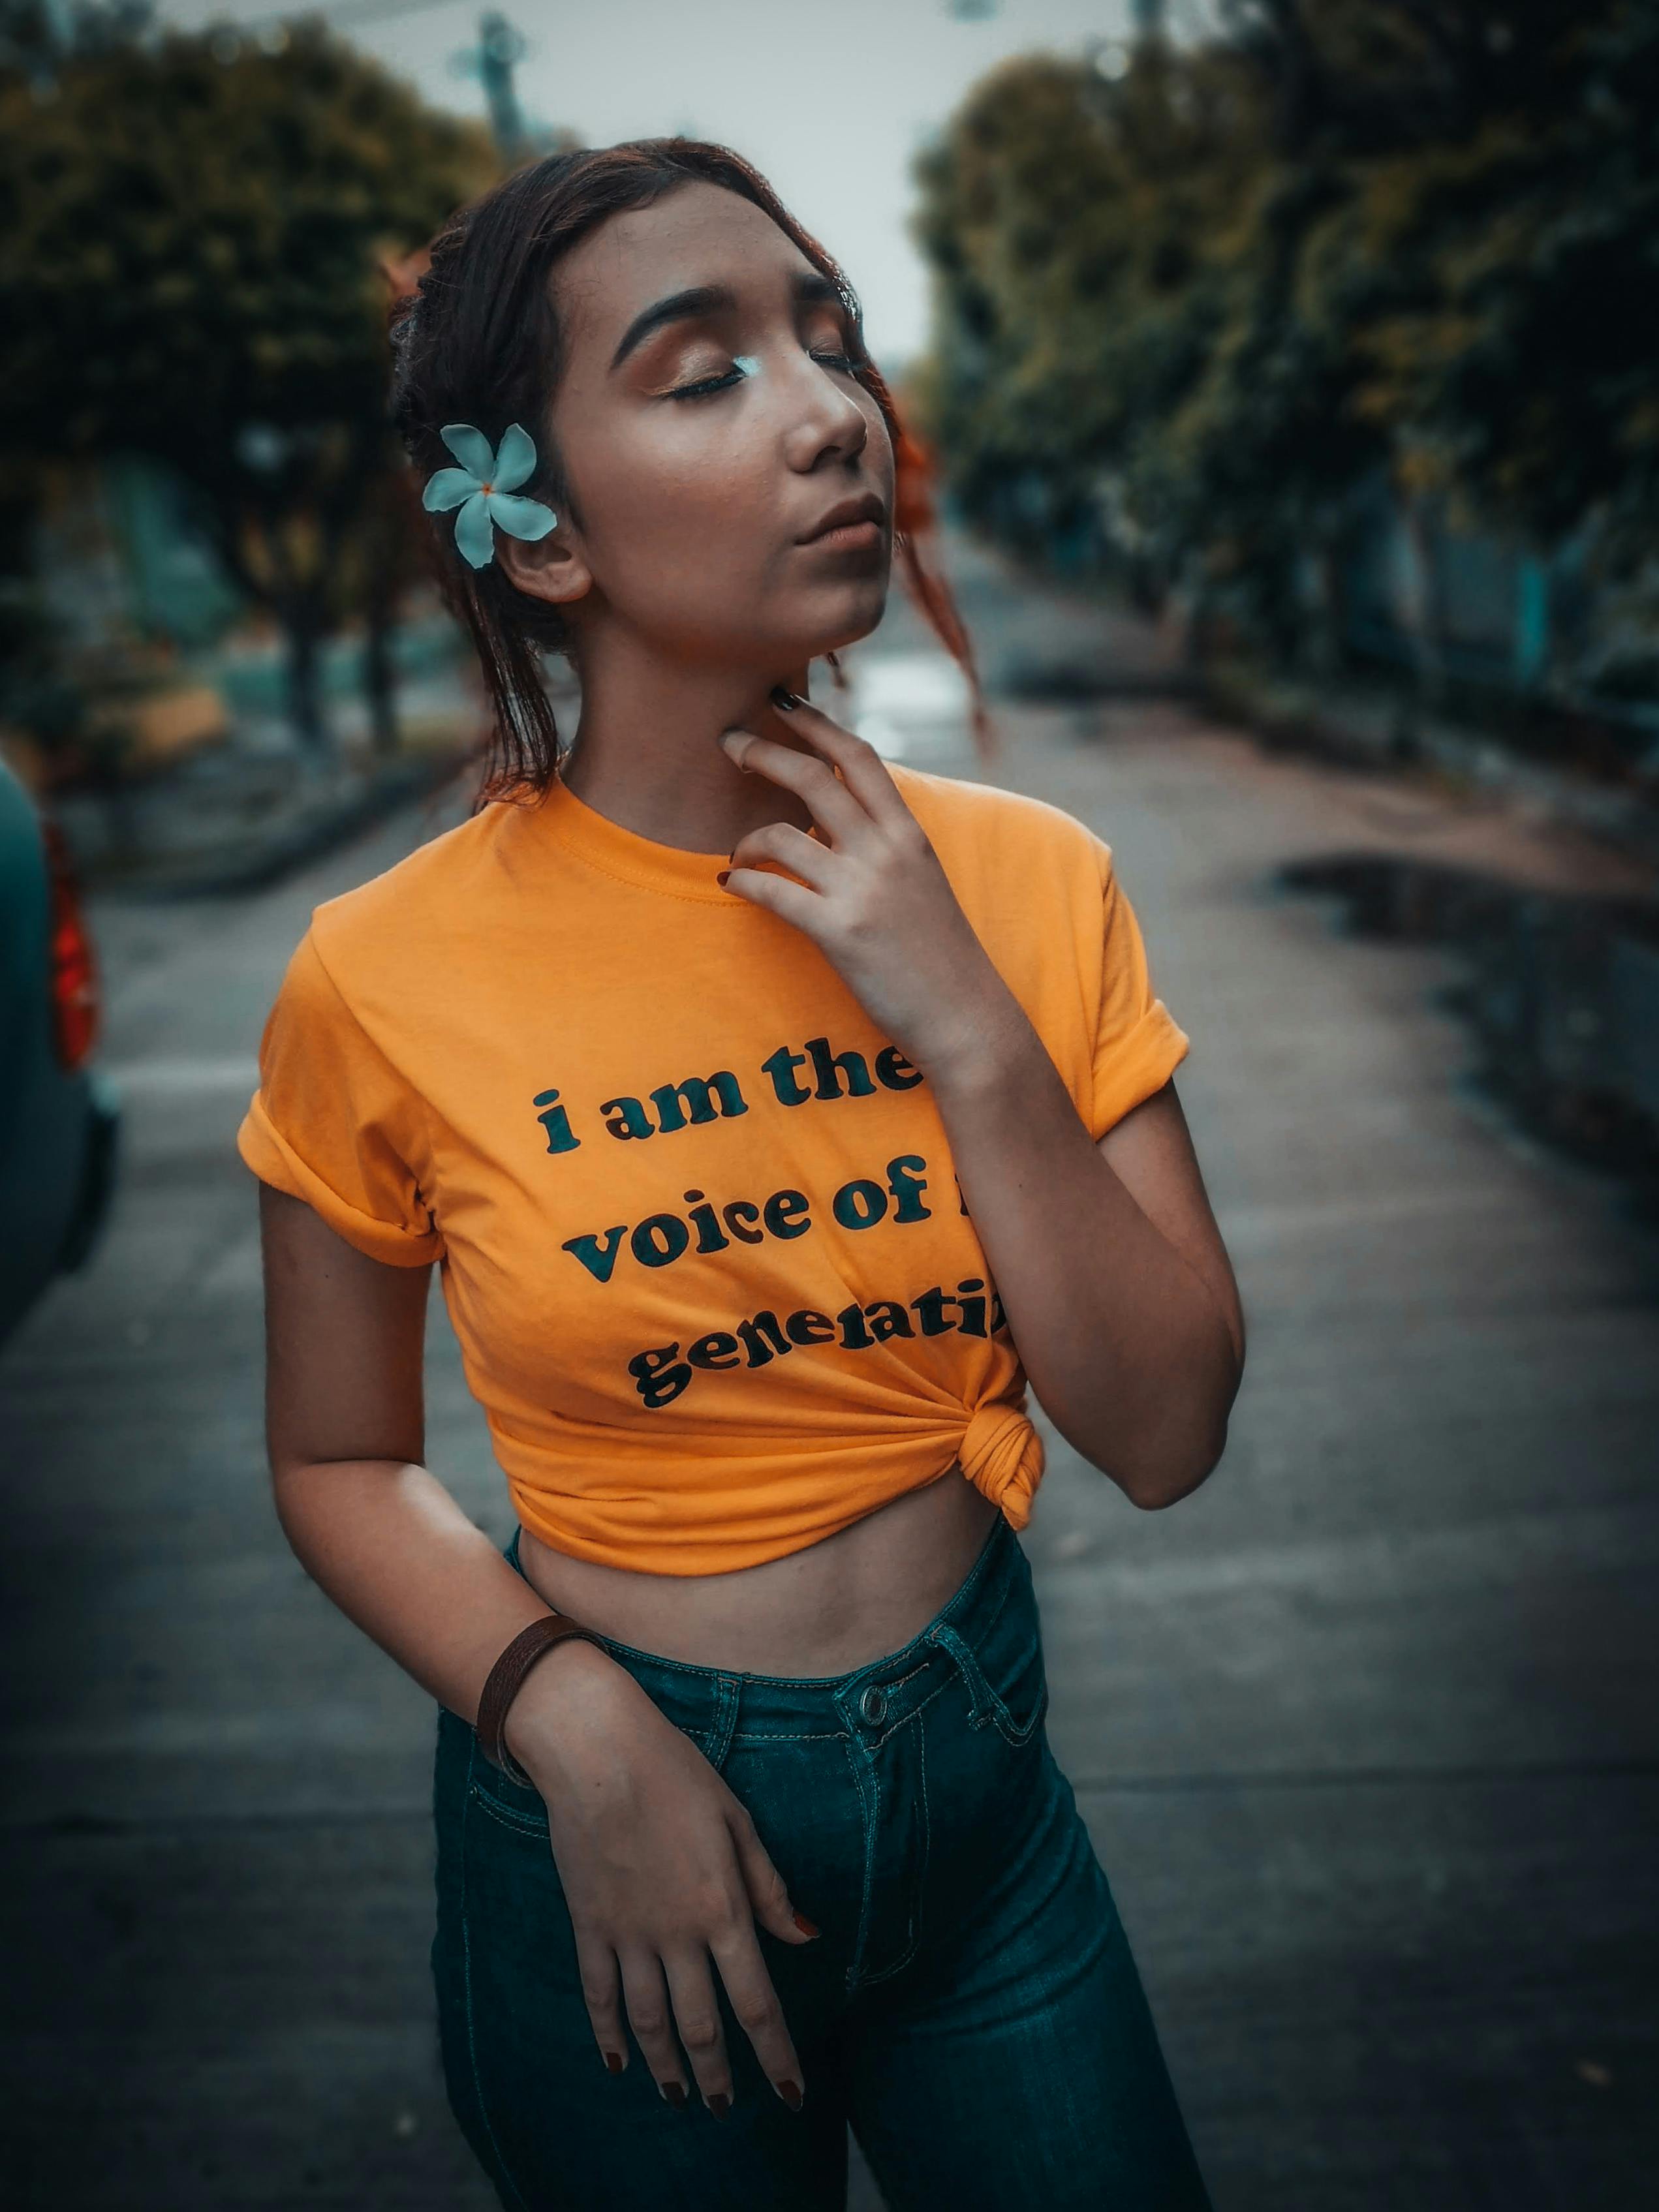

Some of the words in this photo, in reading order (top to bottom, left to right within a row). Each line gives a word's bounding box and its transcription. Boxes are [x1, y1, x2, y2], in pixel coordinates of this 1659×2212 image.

[533, 1088, 581, 1154] i
[599, 1070, 750, 1141] am
[761, 1037, 925, 1107] the
[561, 1189, 813, 1283] voice
[831, 1154, 933, 1231] of
